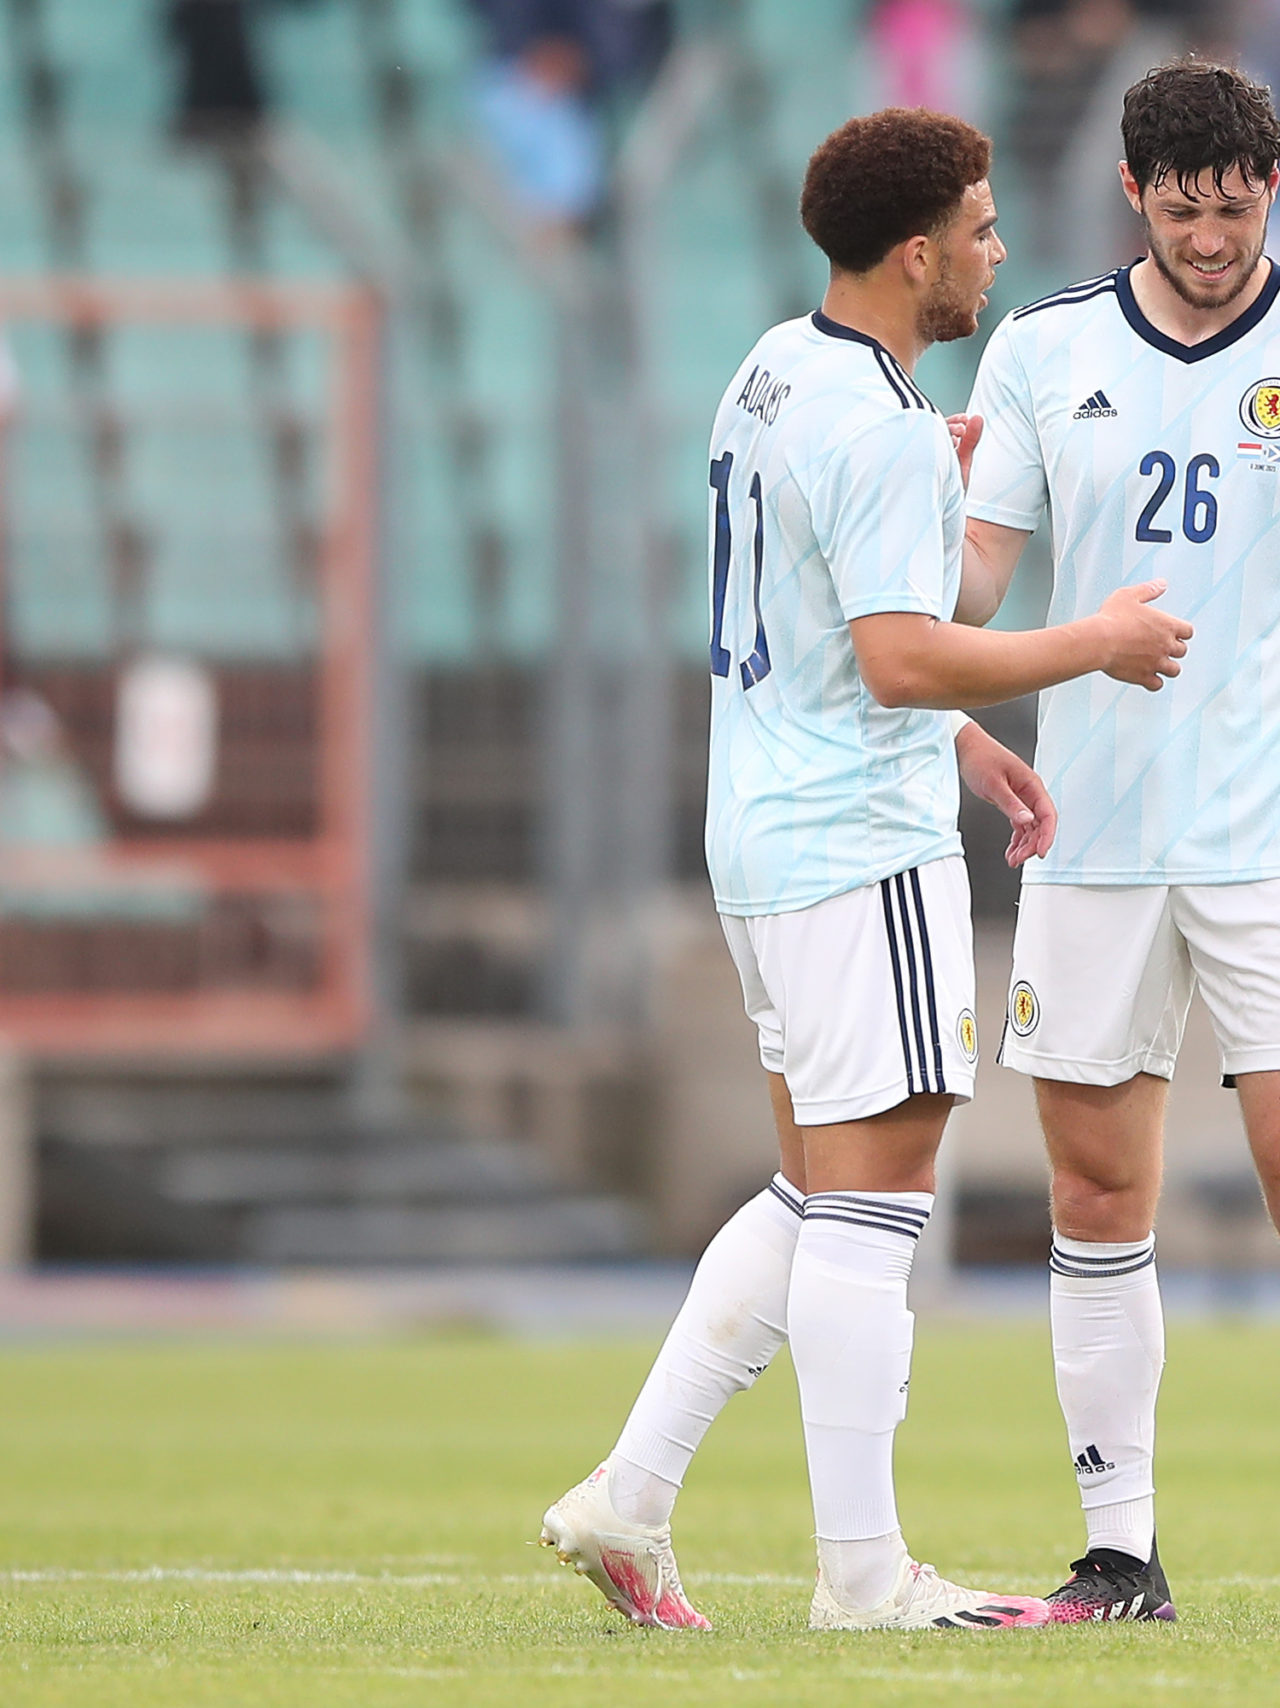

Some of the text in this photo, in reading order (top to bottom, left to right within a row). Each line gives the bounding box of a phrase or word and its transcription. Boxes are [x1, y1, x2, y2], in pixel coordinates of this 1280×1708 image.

[736, 364, 791, 427] ADAMS
[1073, 407, 1118, 420] adidas
[1136, 450, 1220, 543] 26
